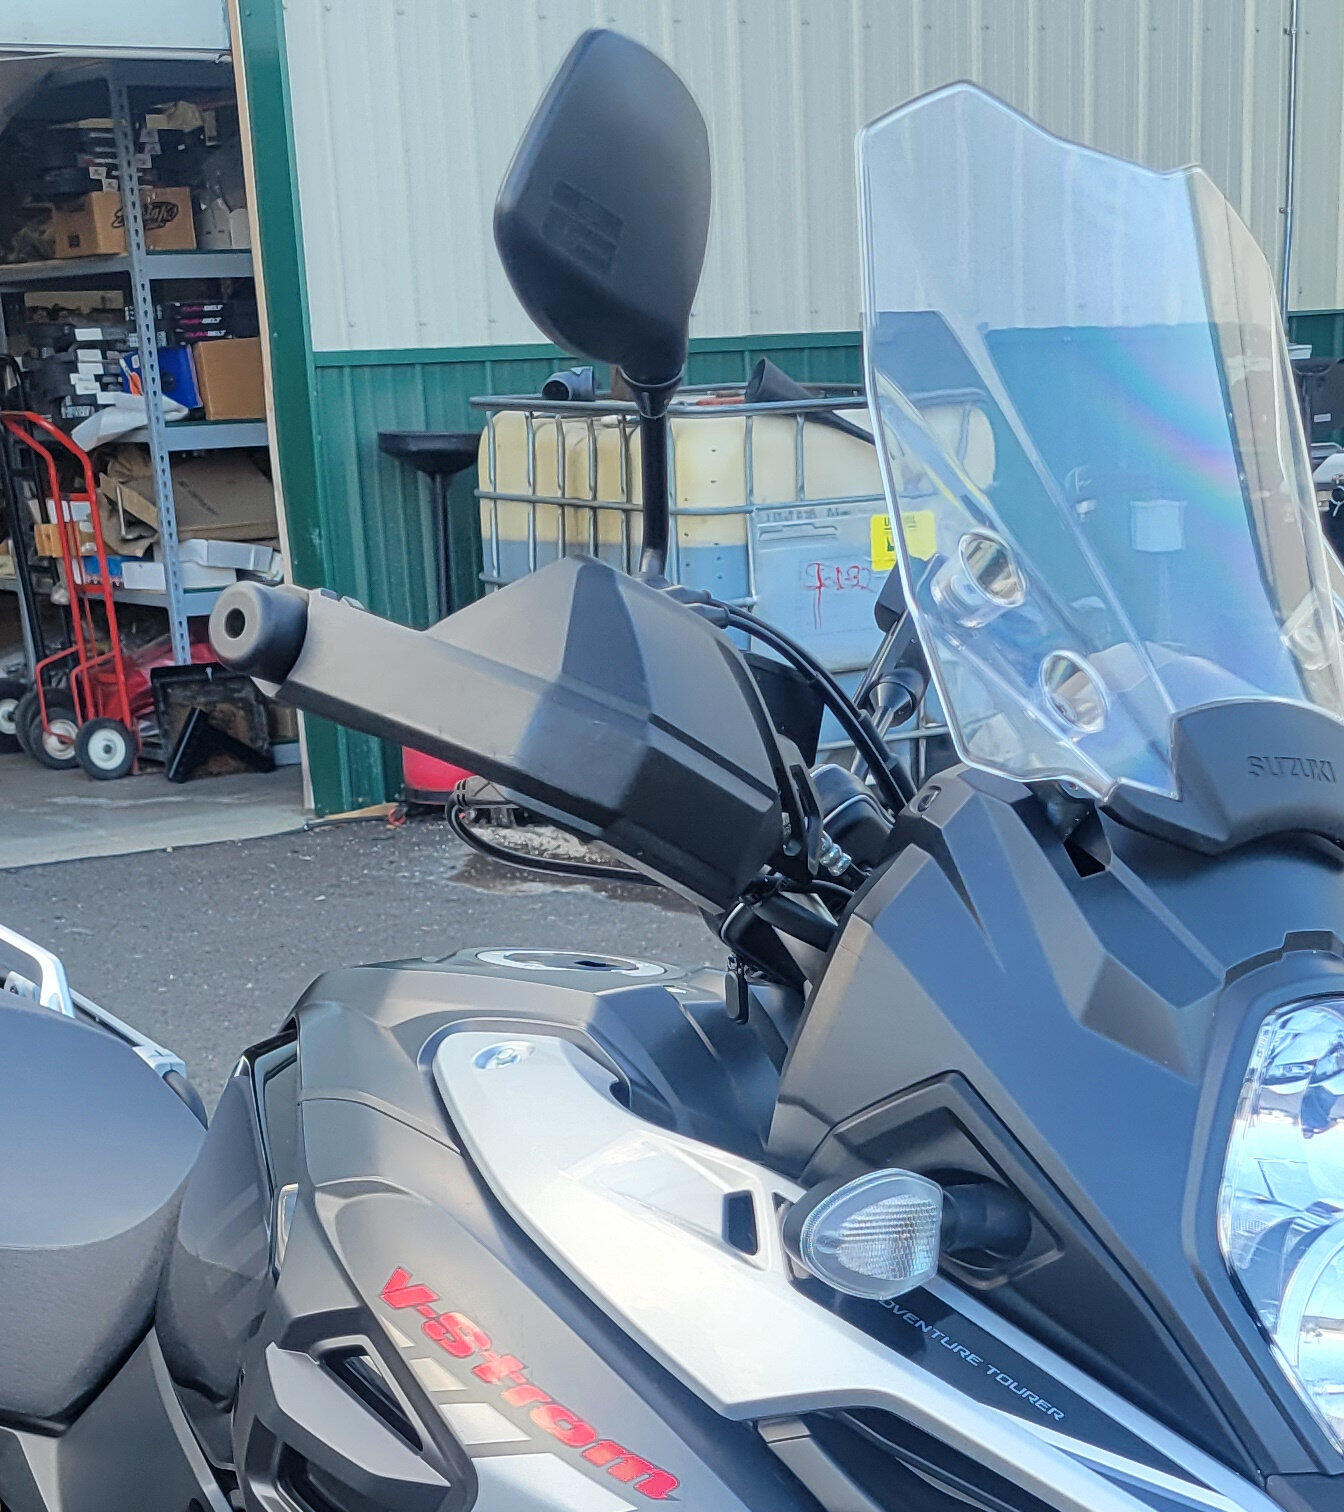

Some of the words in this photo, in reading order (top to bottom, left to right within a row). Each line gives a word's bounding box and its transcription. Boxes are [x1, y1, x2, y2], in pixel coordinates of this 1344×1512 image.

[1248, 755, 1337, 783] SUZUKI
[878, 1296, 984, 1367] DVENTURE
[985, 1364, 1066, 1421] TOURER
